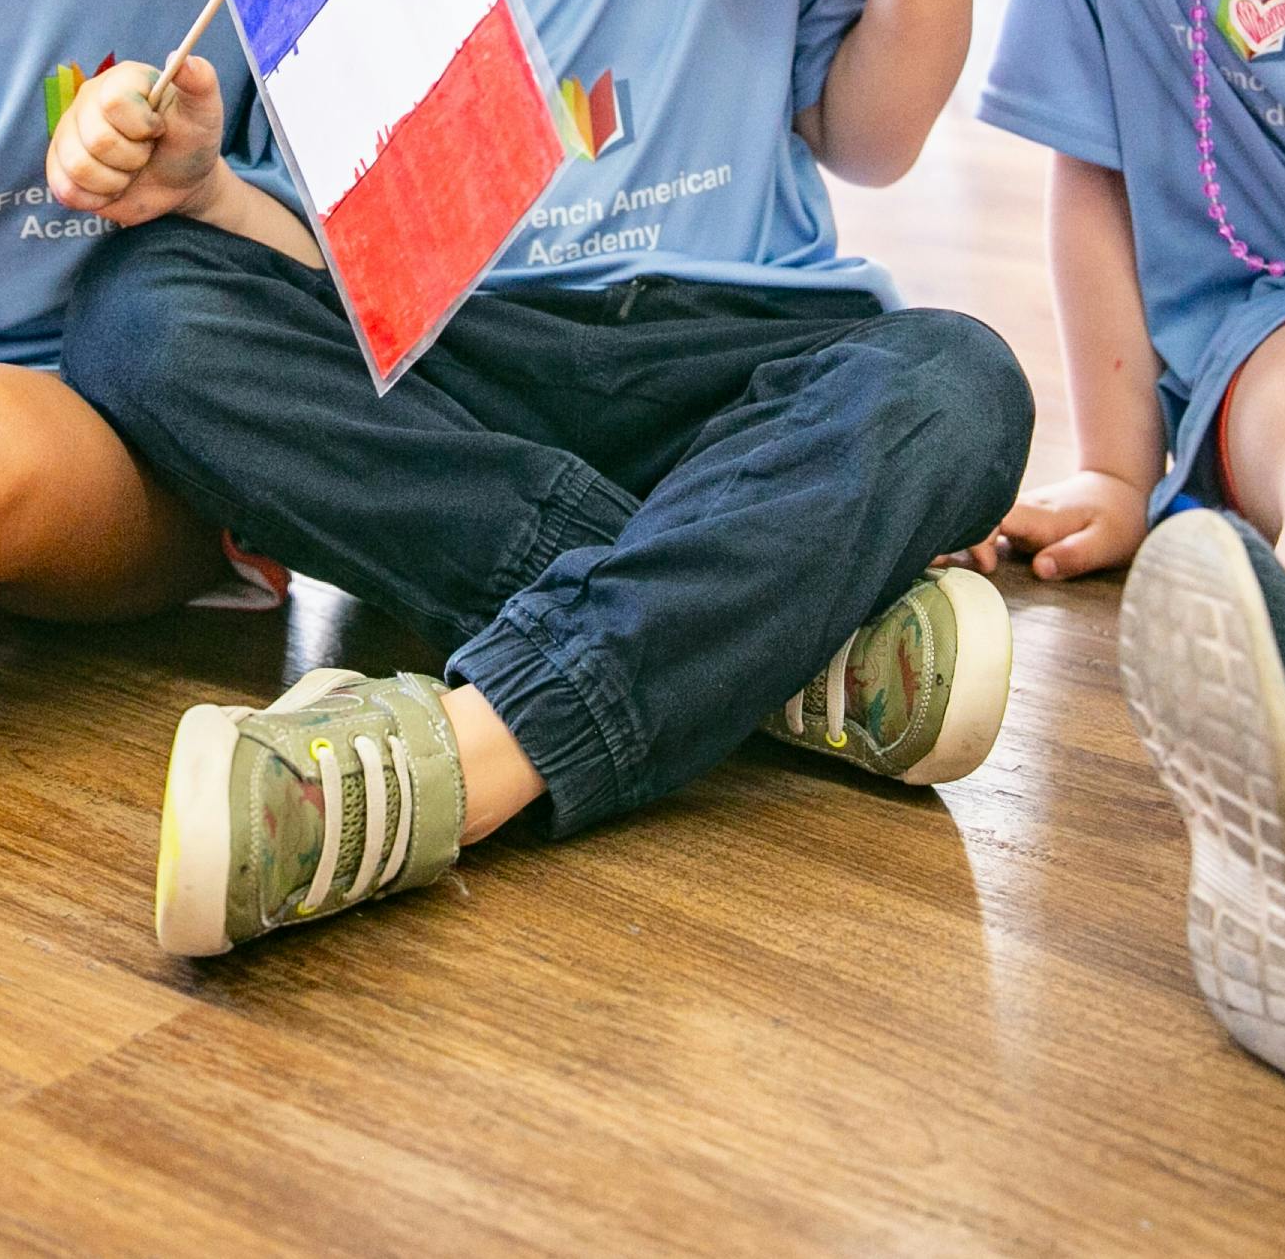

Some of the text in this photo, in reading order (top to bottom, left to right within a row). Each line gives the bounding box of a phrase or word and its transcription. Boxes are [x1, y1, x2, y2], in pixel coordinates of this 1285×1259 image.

[527, 164, 731, 229] ench American
[20, 214, 126, 240] Acade
[527, 222, 661, 267] Academy
